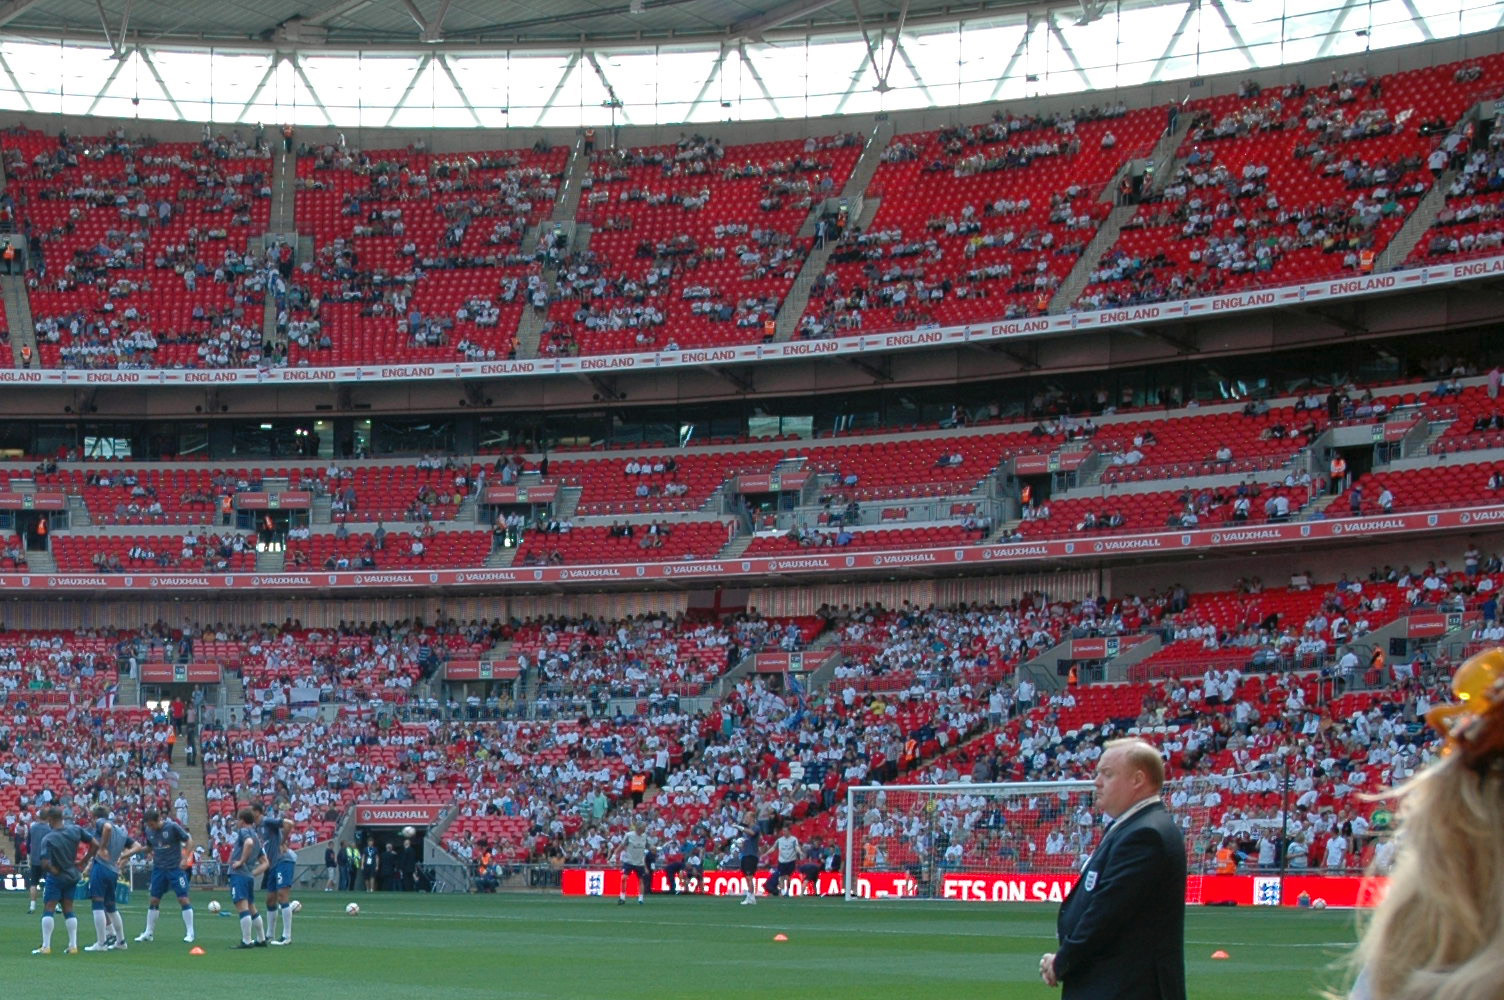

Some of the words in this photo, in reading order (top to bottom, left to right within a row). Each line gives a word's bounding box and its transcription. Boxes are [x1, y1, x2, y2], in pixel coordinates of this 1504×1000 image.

[87, 372, 139, 382] ENGLAND
[184, 372, 237, 382] ENGLAND
[283, 370, 336, 381] ENGLAND
[381, 367, 435, 378] ENGLAND
[480, 362, 534, 374] ENGLAND
[580, 356, 635, 369] ENGLAND
[681, 349, 736, 362] ENGLAND
[782, 341, 838, 355] ENGLAND
[886, 331, 943, 346] ENGLAND
[991, 319, 1049, 335] ENGLAND
[1099, 306, 1160, 323] ENGLAND
[1211, 292, 1275, 311] ENGLAND
[1330, 276, 1396, 295] ENGLAND
[1454, 260, 1504, 278] ENGLA
[57, 577, 107, 586] VAUXHALL
[159, 577, 209, 586] VAUXHALL
[261, 576, 311, 585] VAUXHALL
[363, 574, 414, 584] VAUXHALL
[466, 572, 516, 582] VAUXHALL
[569, 568, 620, 578] VAUXHALL
[673, 563, 723, 574] VAUXHALL
[778, 559, 829, 570] VAUXHALL
[883, 553, 935, 564] VAUXHALL
[993, 546, 1048, 557] VAUXHALL
[1104, 538, 1161, 550] VAUXHALL
[1222, 529, 1281, 542] VAUXHALL
[1344, 519, 1405, 532] VAUXHALL
[372, 810, 430, 819] VAUXHALL
[992, 880, 1026, 902] ON
